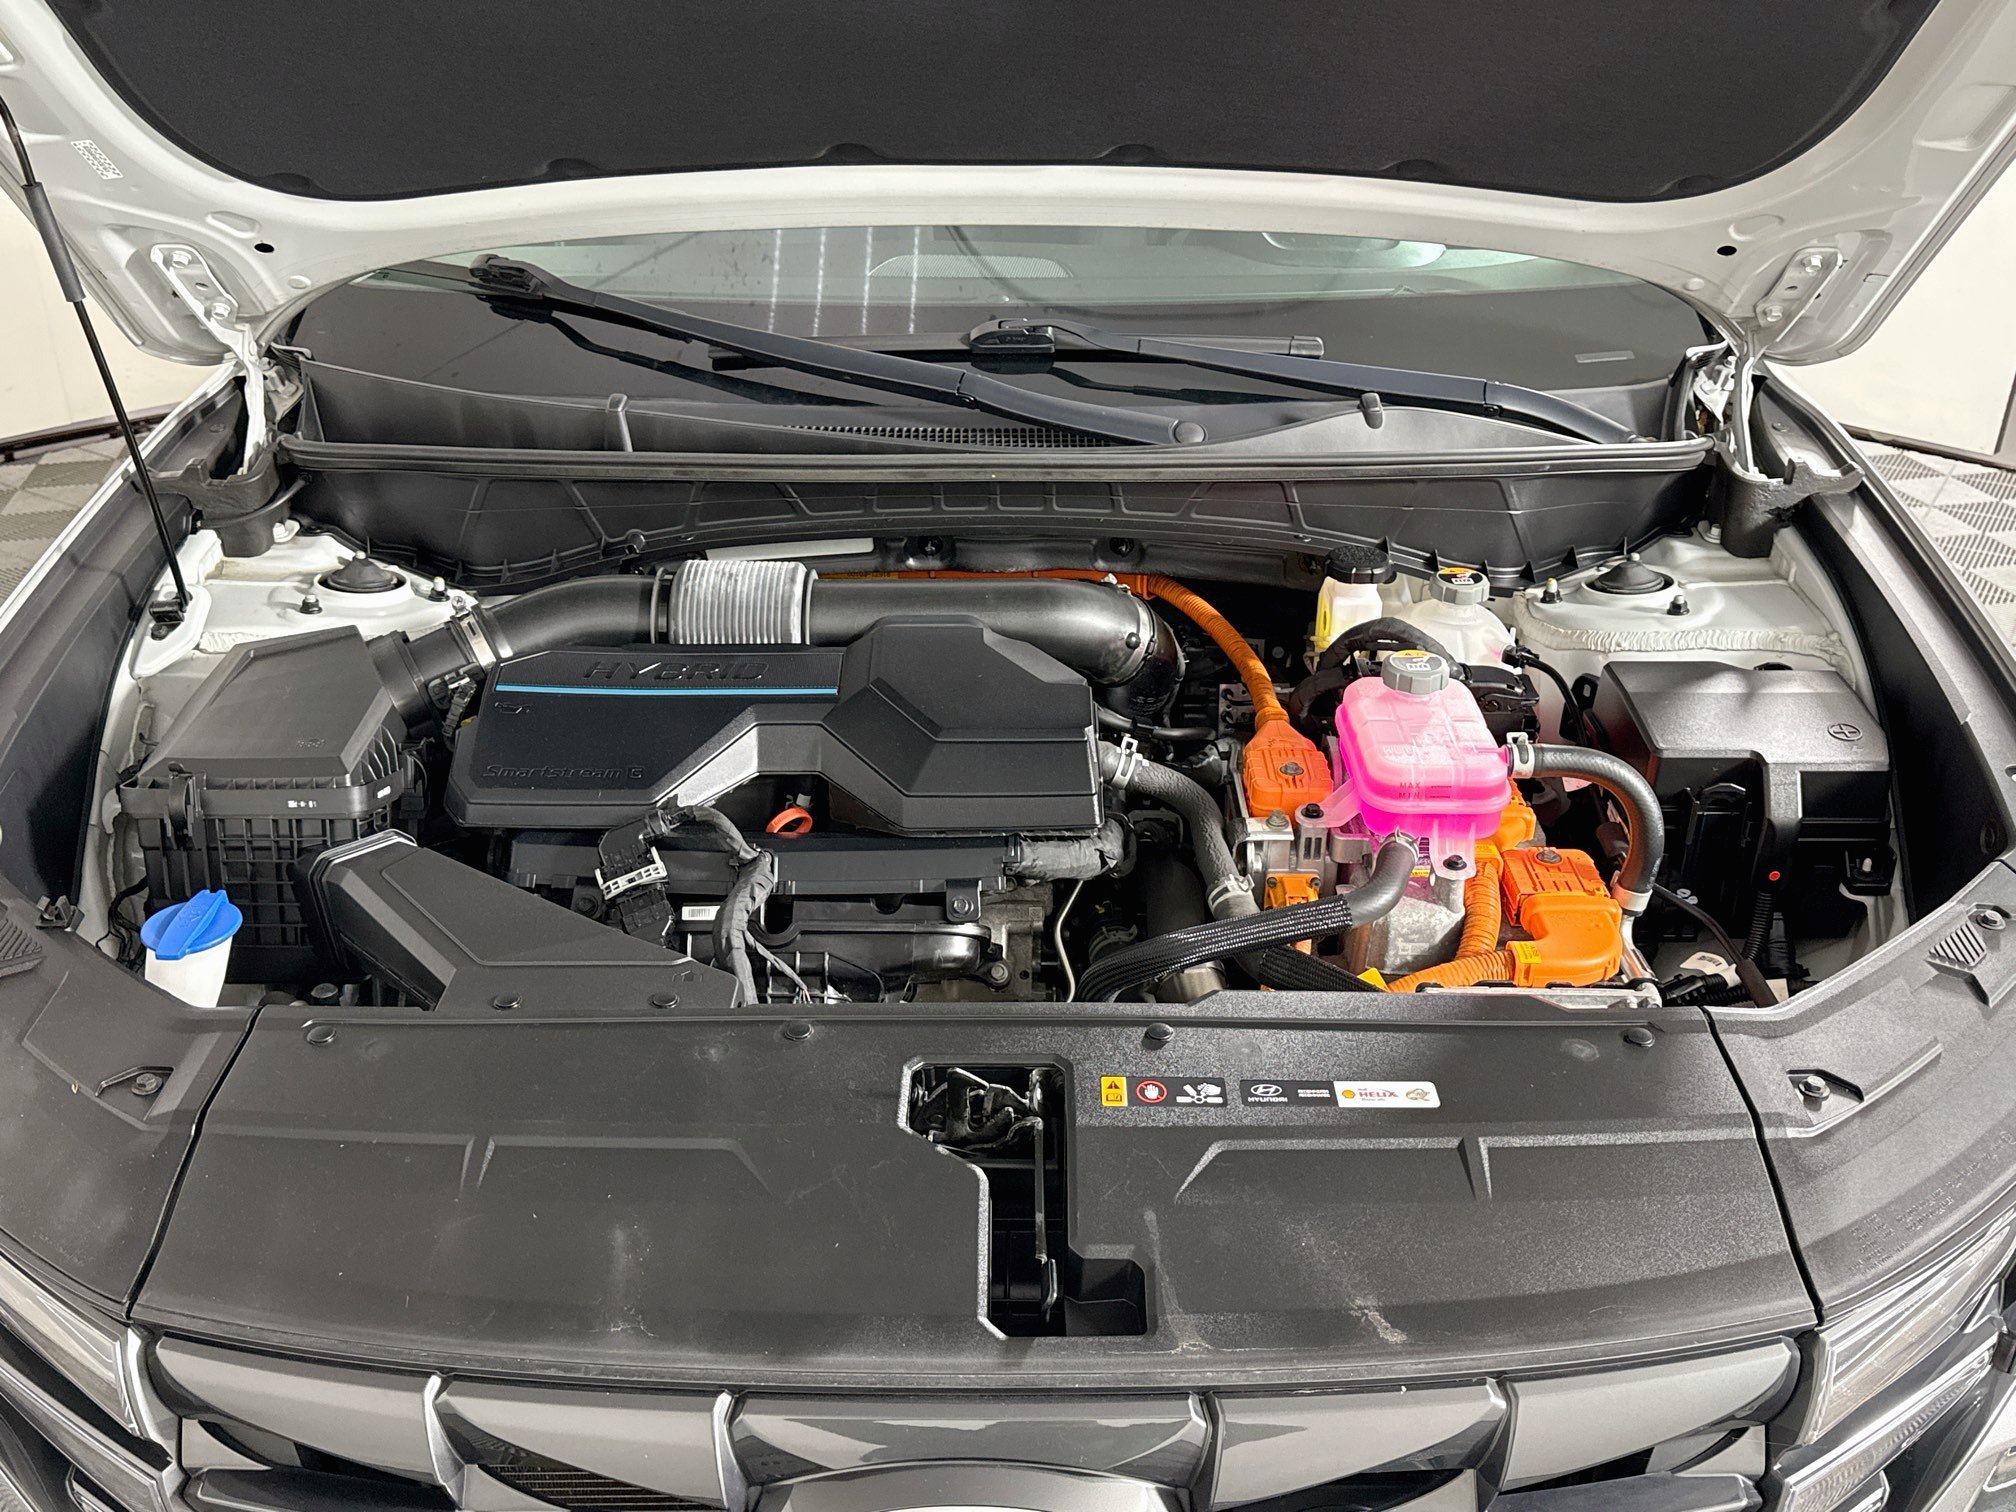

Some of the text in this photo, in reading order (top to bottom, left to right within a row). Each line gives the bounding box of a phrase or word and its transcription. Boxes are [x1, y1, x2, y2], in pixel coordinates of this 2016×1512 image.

[583, 661, 769, 680] HYBRID
[483, 764, 623, 779] Smartstream
[1358, 1090, 1399, 1098] HELIX
